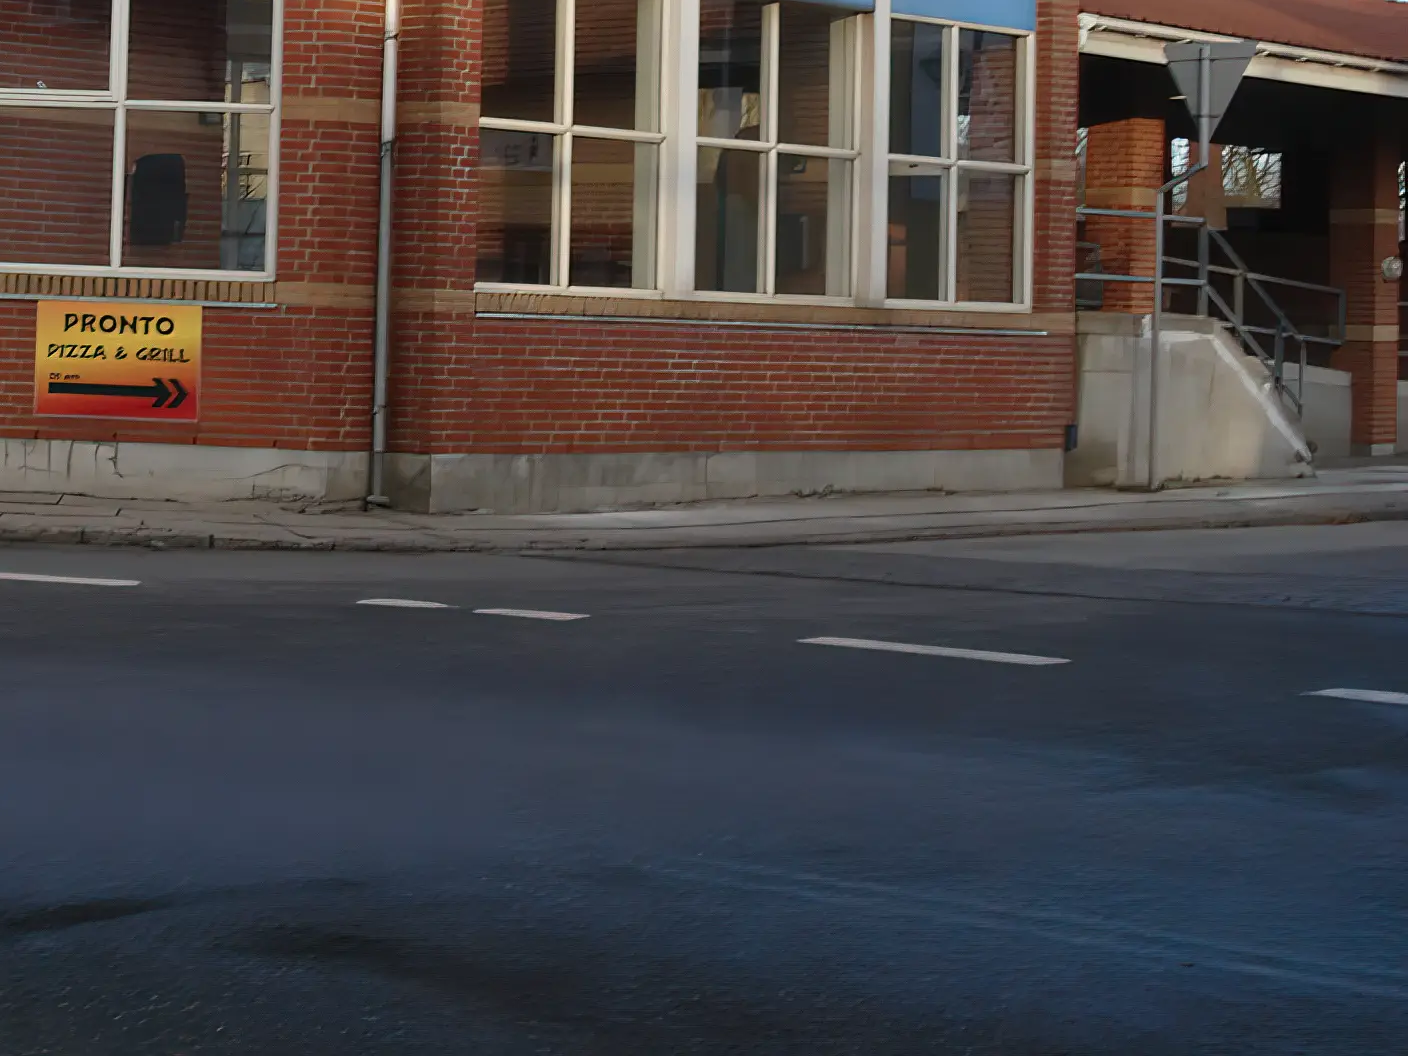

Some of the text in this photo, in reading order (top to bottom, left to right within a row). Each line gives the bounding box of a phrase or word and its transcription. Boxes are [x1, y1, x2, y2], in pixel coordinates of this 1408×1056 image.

[64, 313, 174, 335] PRONTO
[47, 344, 191, 363] PIZZA & GRILL
